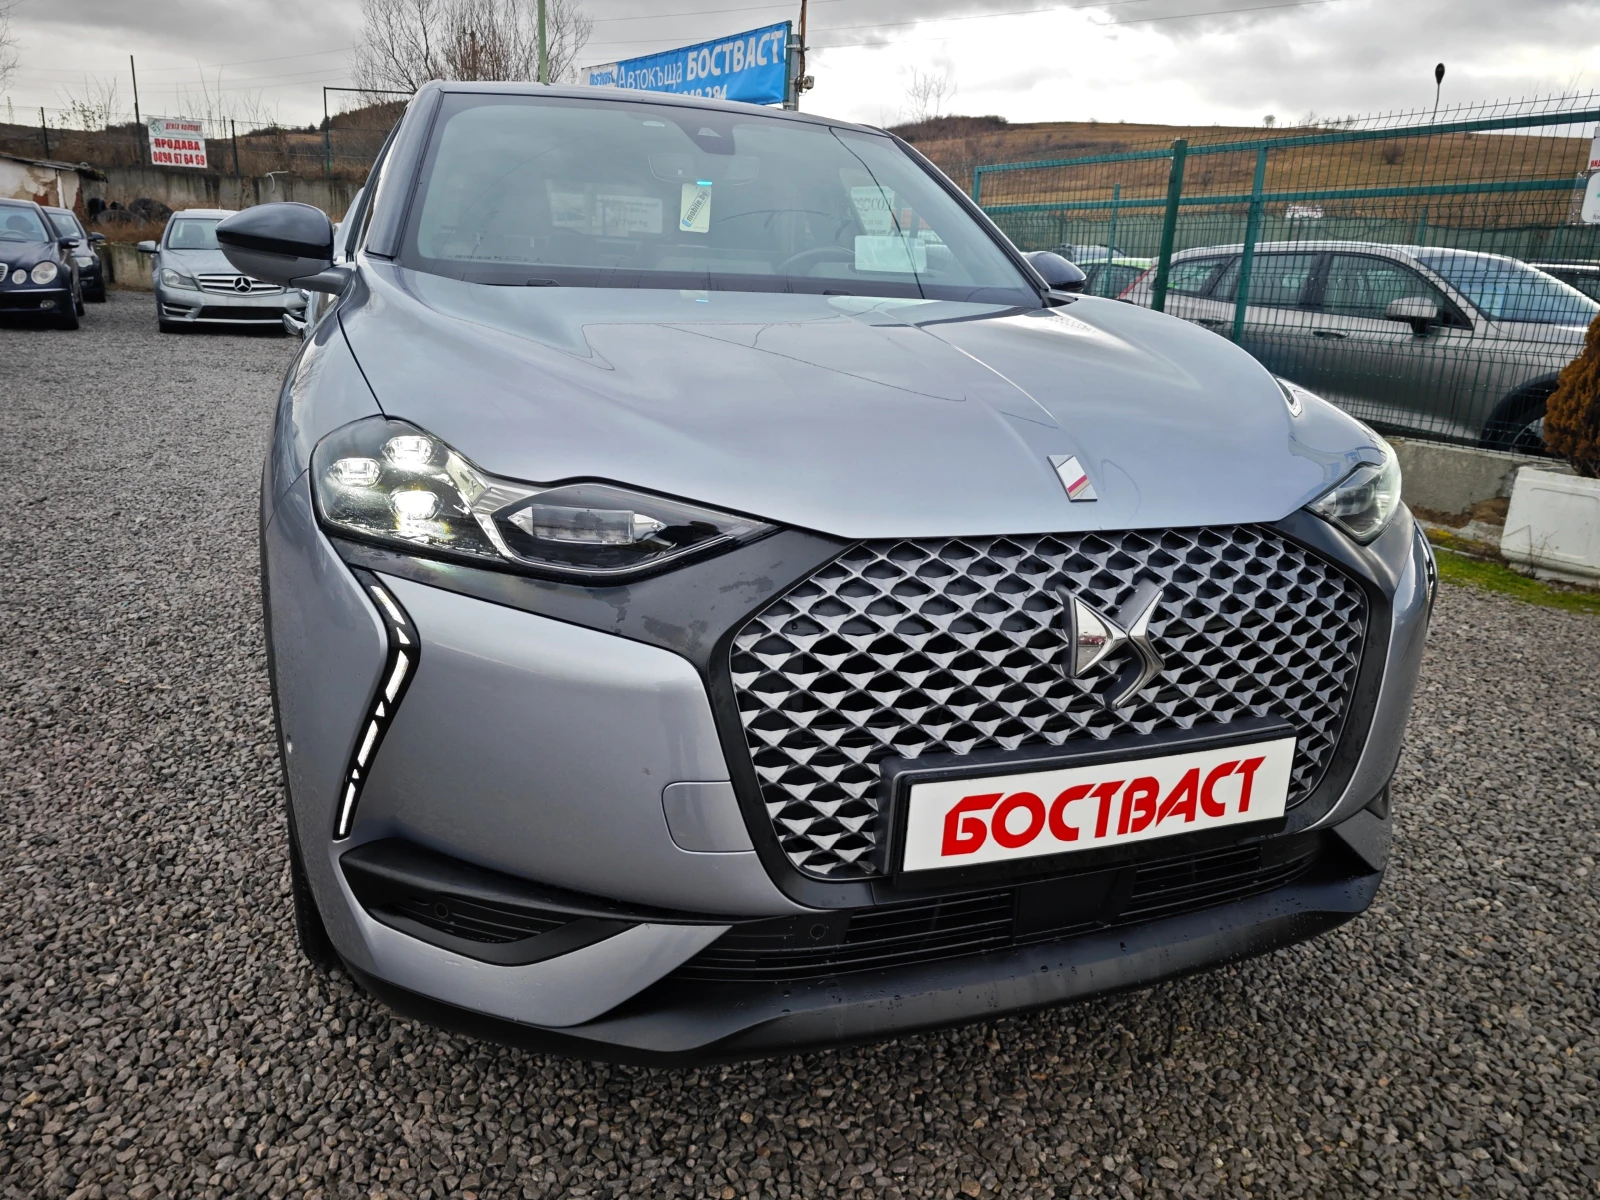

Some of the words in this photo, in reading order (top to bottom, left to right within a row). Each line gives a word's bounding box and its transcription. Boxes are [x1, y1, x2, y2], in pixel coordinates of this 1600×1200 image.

[686, 30, 784, 82] БОСТВАСТ
[153, 151, 173, 163] 0898
[173, 152, 182, 164] 67
[183, 153, 194, 165] 64
[195, 154, 205, 166] 69
[154, 138, 200, 151] ПРОДАВА
[686, 190, 709, 222] mobile.bg
[940, 755, 1267, 857] БОСТВАСТ
